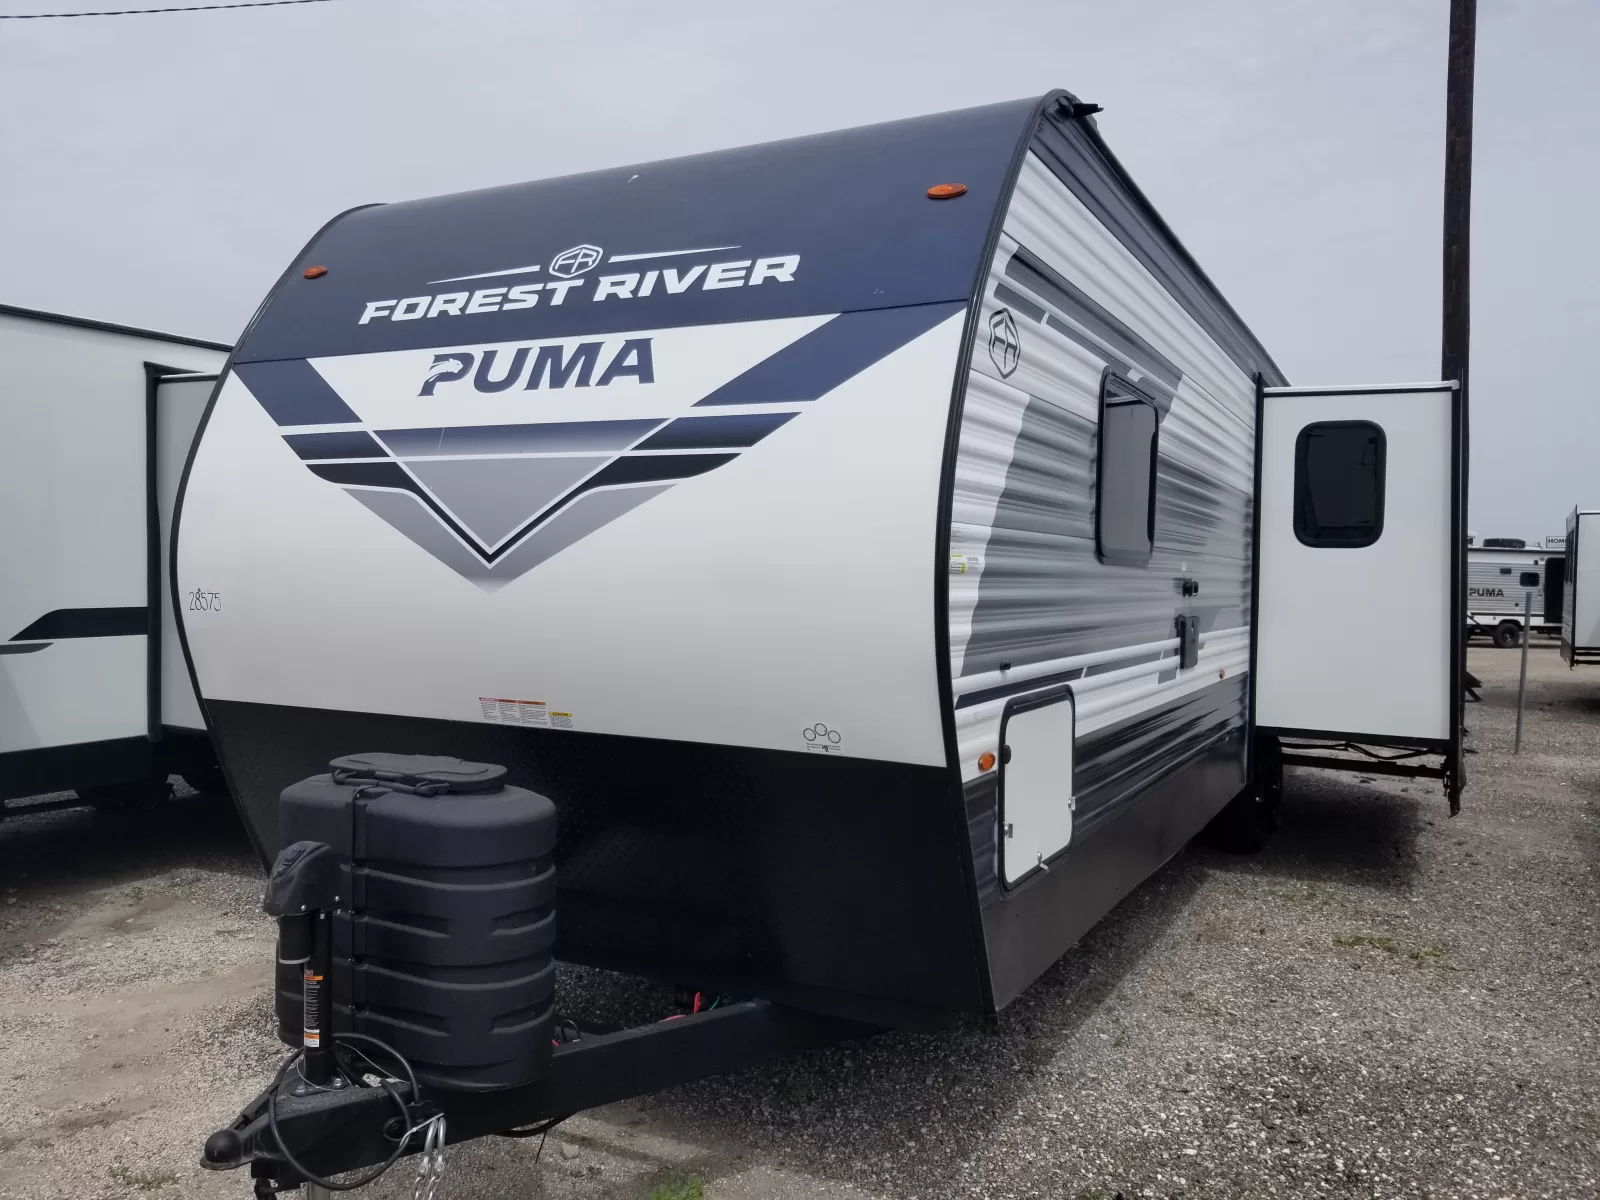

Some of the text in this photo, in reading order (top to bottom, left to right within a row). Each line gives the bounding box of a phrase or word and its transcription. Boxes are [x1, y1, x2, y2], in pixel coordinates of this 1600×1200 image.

[358, 254, 801, 325] FOREST RIVER
[417, 337, 655, 397] PUMA
[189, 591, 222, 612] 28575
[1468, 588, 1504, 597] PUMA
